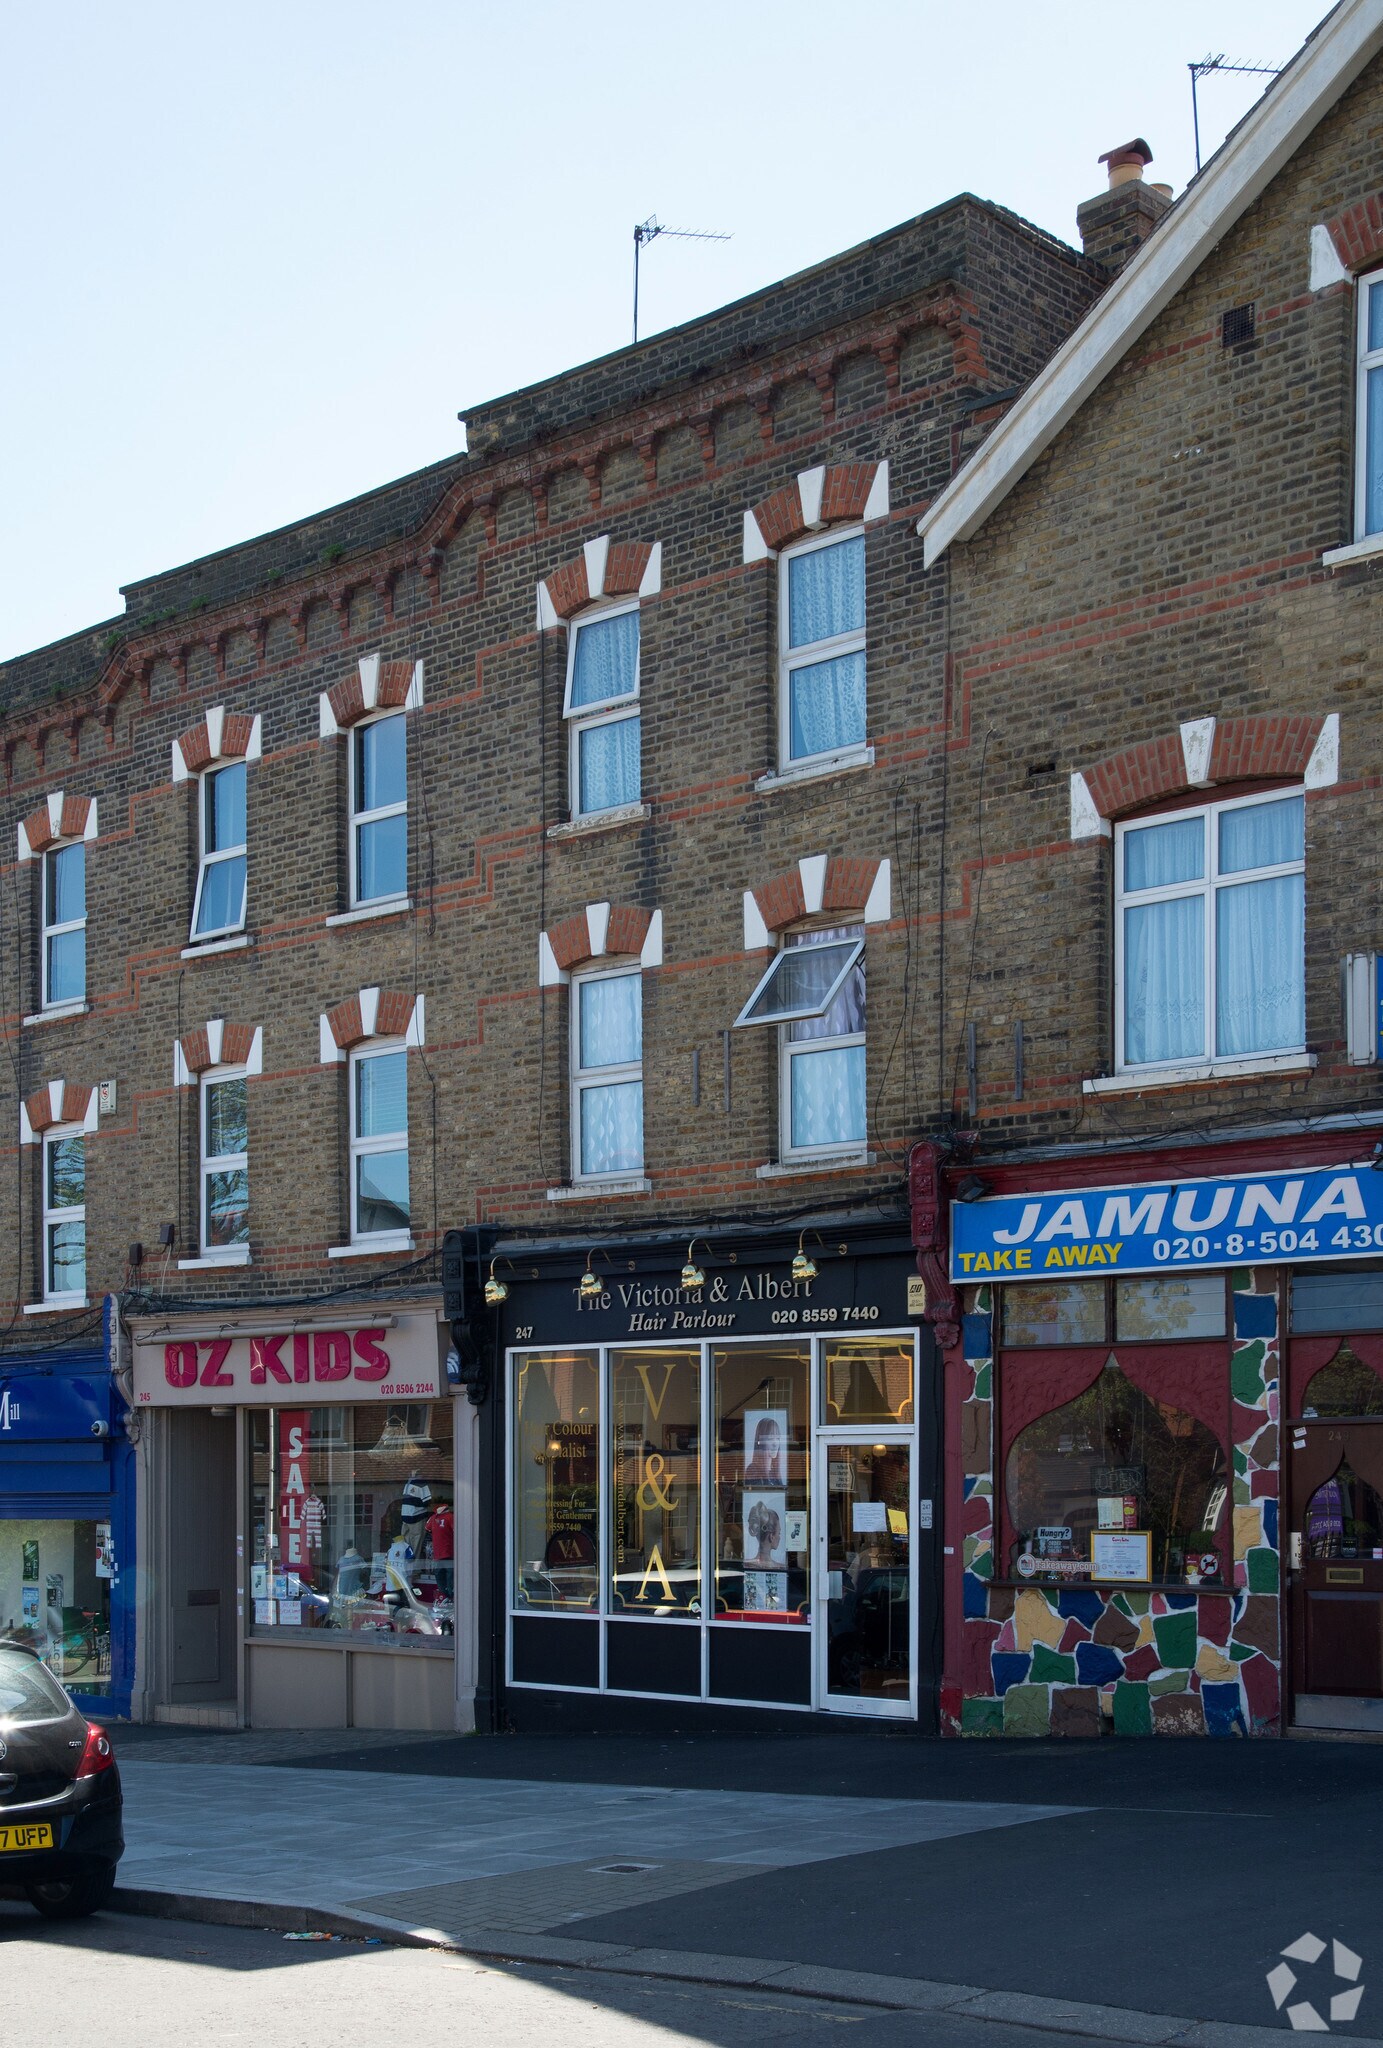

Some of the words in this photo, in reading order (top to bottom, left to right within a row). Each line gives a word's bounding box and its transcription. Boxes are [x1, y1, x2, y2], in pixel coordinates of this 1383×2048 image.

[992, 1176, 1367, 1244] JAMUNA
[958, 1248, 1032, 1272] TAKE
[1045, 1242, 1123, 1267] AWAY
[709, 1276, 730, 1302] &
[737, 1272, 813, 1301] Albert
[628, 1312, 667, 1332] Hair
[671, 1310, 736, 1330] Parlour
[771, 1310, 798, 1324] 020
[802, 1307, 837, 1322] 8559
[842, 1305, 879, 1320] 7440
[515, 1327, 533, 1339] 247
[165, 1339, 234, 1388] OZ
[250, 1329, 392, 1384] KIDS
[139, 1392, 151, 1401] 245
[380, 1384, 394, 1395] 020
[395, 1383, 414, 1394] 8506
[415, 1382, 434, 1394] 2244
[634, 1363, 677, 1422] V
[553, 1421, 593, 1436] Colour
[636, 1453, 679, 1511] &
[286, 1427, 304, 1564] SALE
[556, 1510, 593, 1520] Gentlemen
[566, 1522, 582, 1532] 7440
[1040, 1528, 1070, 1539] Hungry?
[635, 1544, 677, 1600] A
[1036, 1560, 1097, 1573] Takeaway.com
[15, 1826, 48, 1847] UFP
